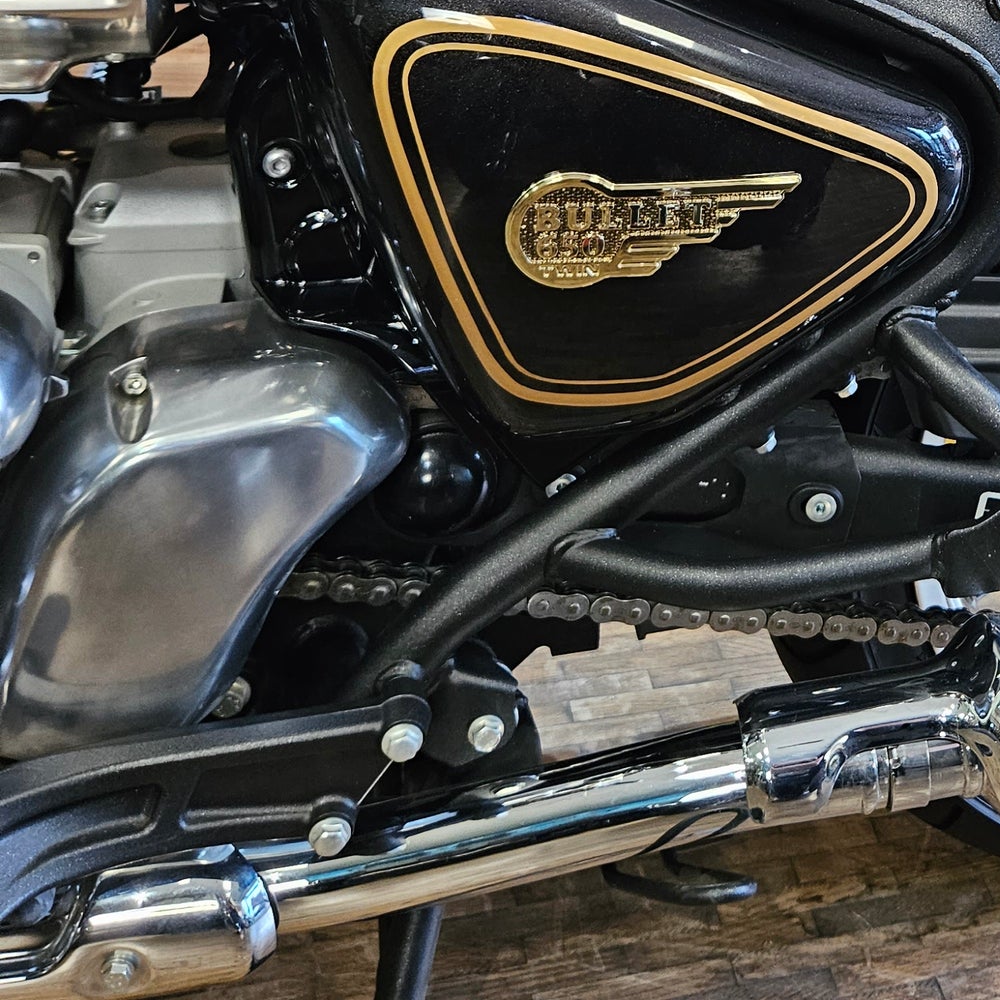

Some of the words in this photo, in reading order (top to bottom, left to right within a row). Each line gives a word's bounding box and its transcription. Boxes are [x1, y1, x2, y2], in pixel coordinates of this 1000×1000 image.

[535, 198, 712, 231] BULLET
[535, 231, 605, 259] 650
[538, 264, 600, 279] TWIN
